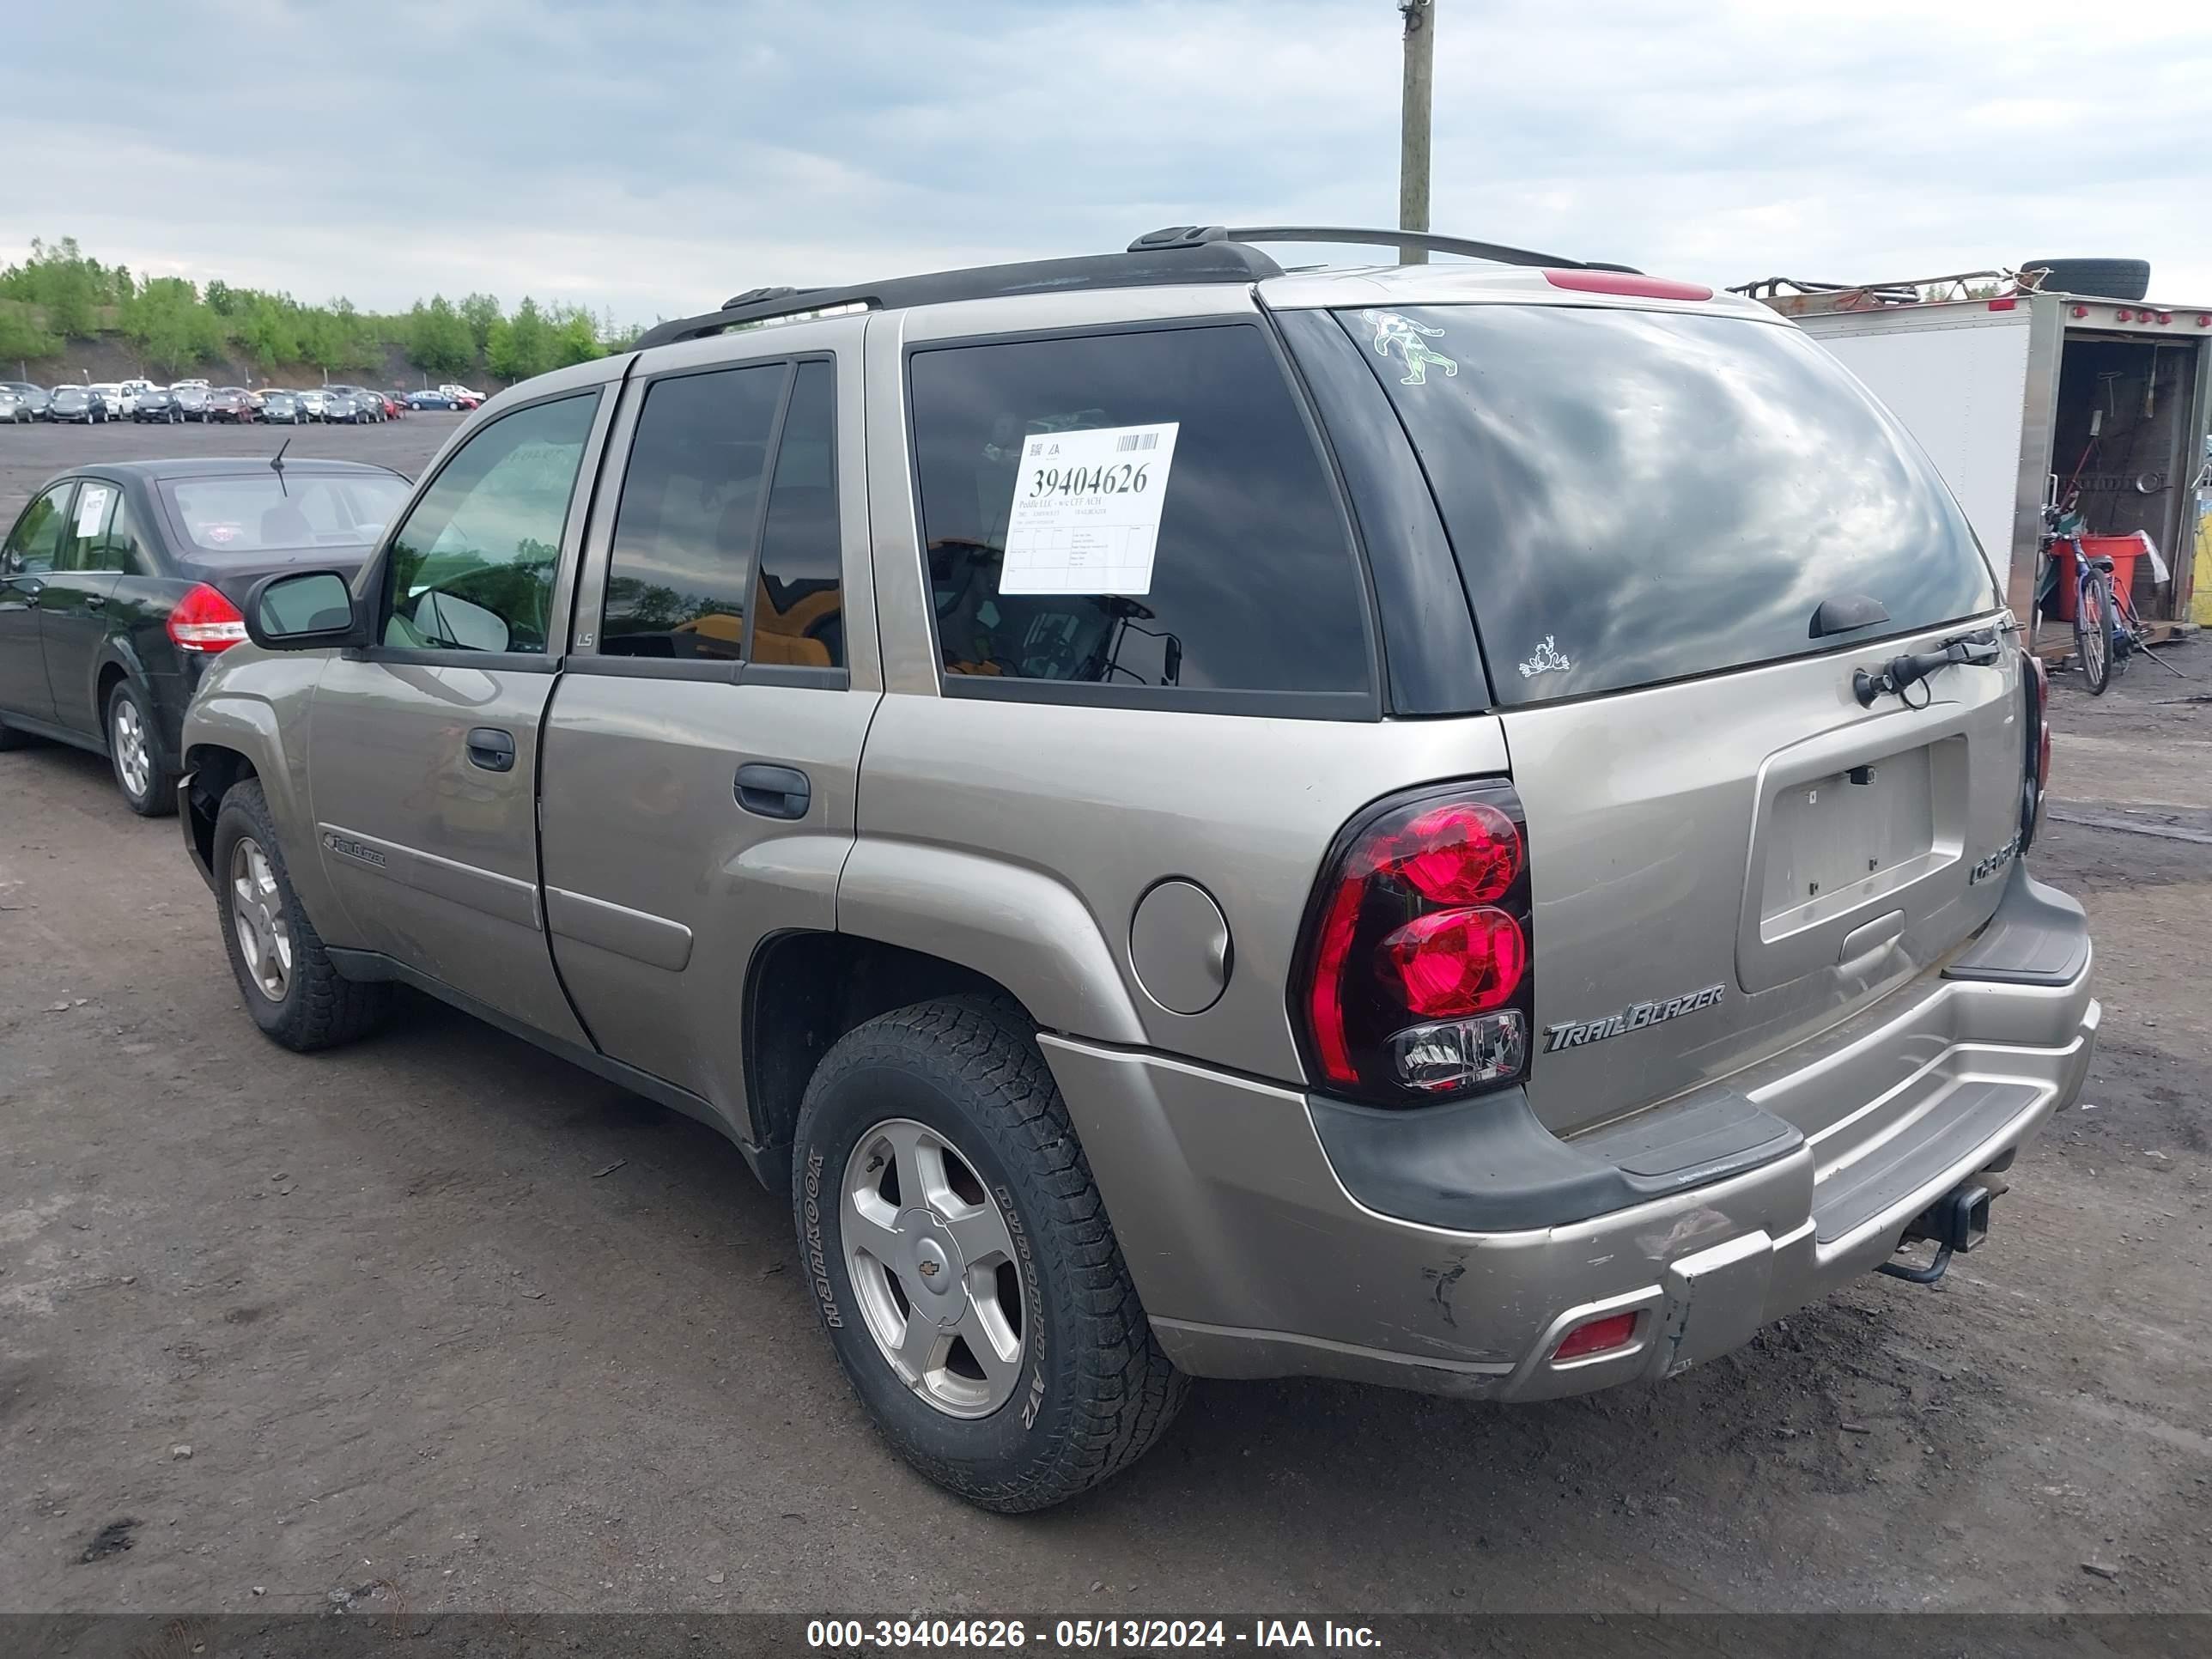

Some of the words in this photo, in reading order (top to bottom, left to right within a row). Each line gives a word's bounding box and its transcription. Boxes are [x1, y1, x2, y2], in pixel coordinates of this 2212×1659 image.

[1030, 462, 1151, 498] 39404626
[576, 633, 593, 647] LS
[1543, 982, 1726, 1054] TRAILBLAZER
[1021, 1364, 1046, 1431] AT2
